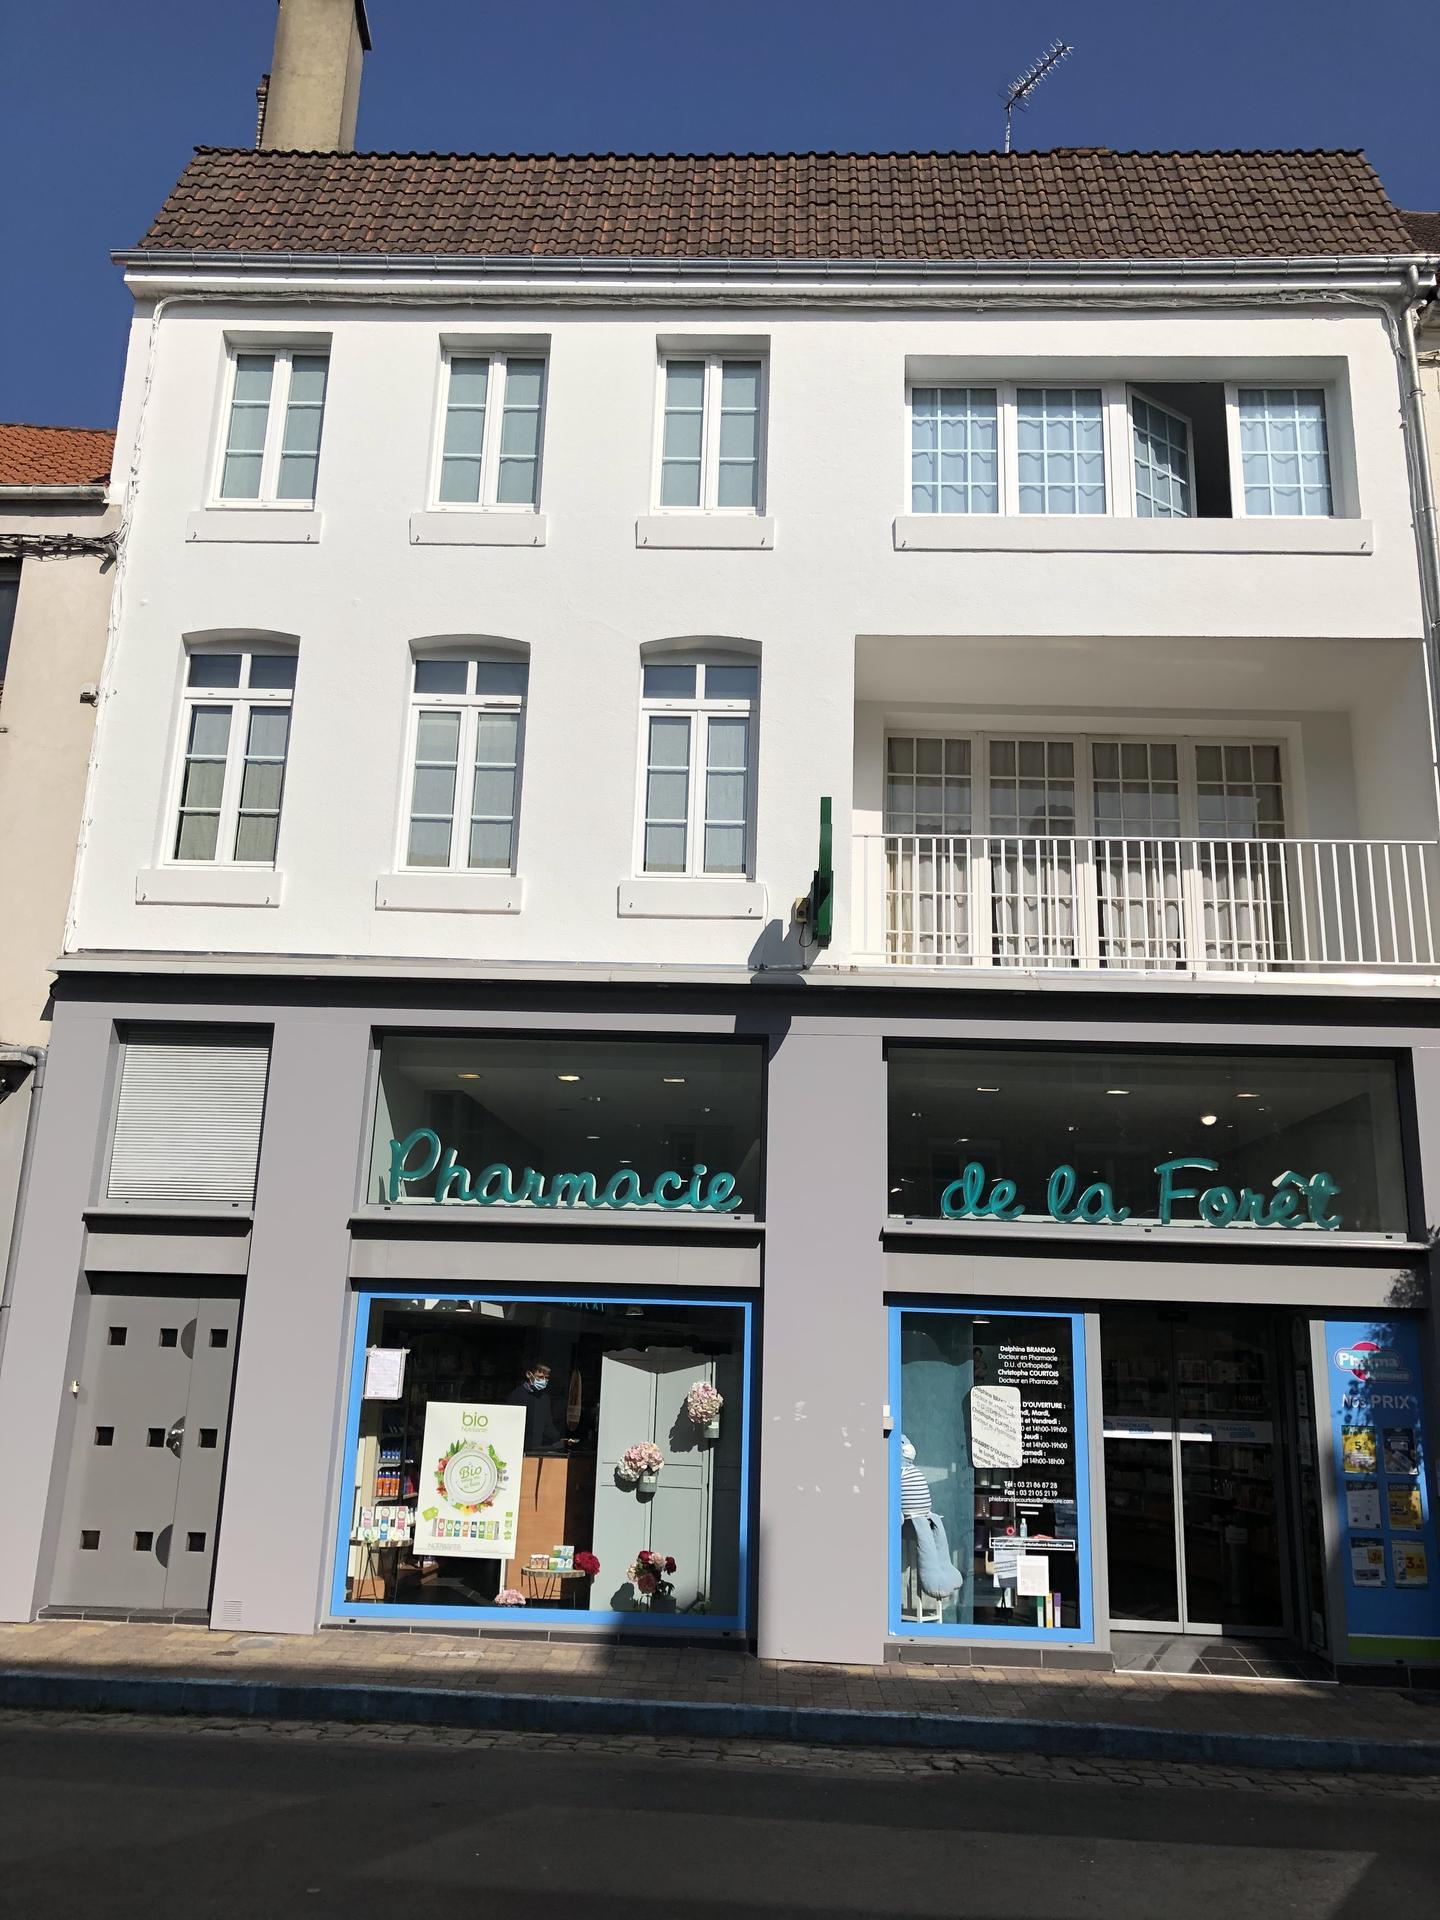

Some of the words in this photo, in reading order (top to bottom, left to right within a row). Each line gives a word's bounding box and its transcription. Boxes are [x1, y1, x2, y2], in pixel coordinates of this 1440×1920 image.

[389, 1127, 743, 1213] Pharmacie
[940, 1161, 1025, 1221] de
[1047, 1164, 1132, 1223] la
[1154, 1157, 1342, 1230] Forêt
[1000, 1345, 1026, 1353] Delphine
[1028, 1354, 1058, 1362] Pharmacie
[1017, 1362, 1052, 1370] d'Orthopédie
[998, 1369, 1028, 1377] Christophe
[1371, 1395, 1410, 1409] PRIX
[463, 1411, 488, 1427] bio
[1031, 1417, 1057, 1425] Vendredi
[459, 1465, 482, 1479] Bio
